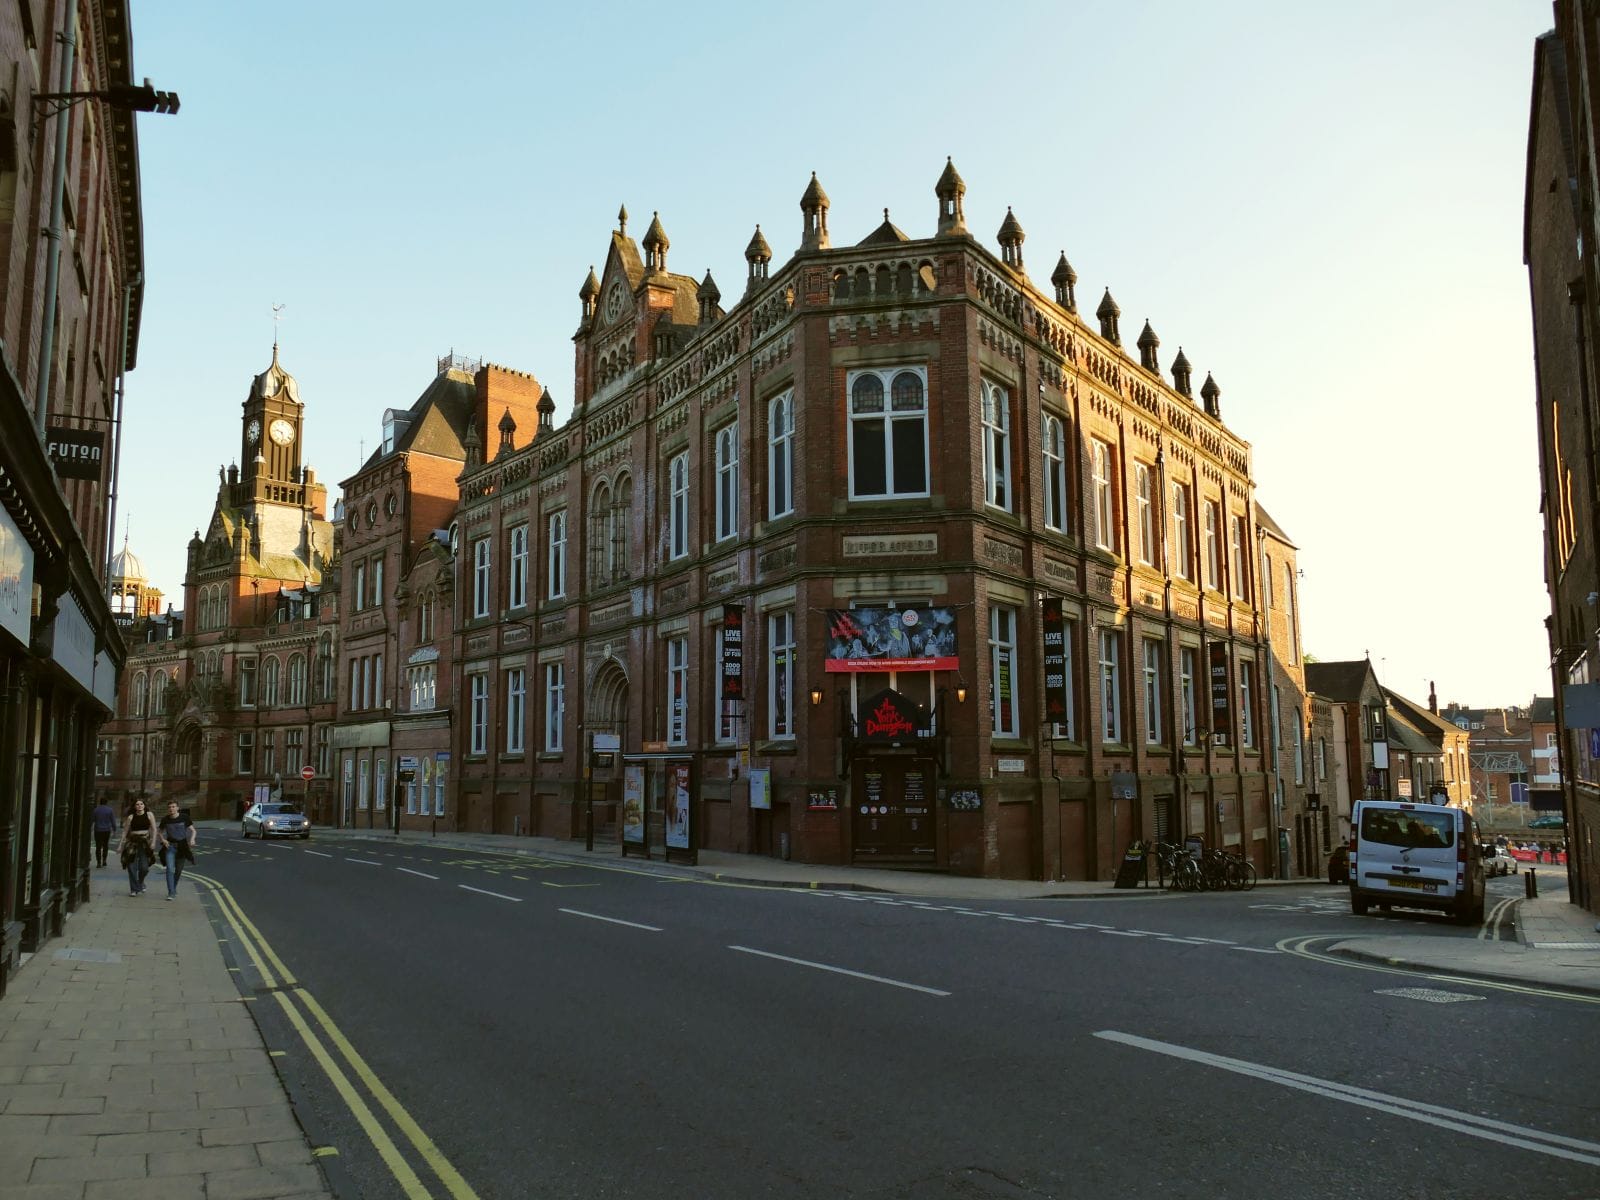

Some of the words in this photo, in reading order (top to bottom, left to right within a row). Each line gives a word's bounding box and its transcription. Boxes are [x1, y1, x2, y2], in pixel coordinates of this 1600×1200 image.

[48, 442, 101, 460] FUTON
[725, 629, 742, 637] LIVE
[1045, 632, 1063, 640] LIVE
[865, 719, 913, 737] Dungeon
